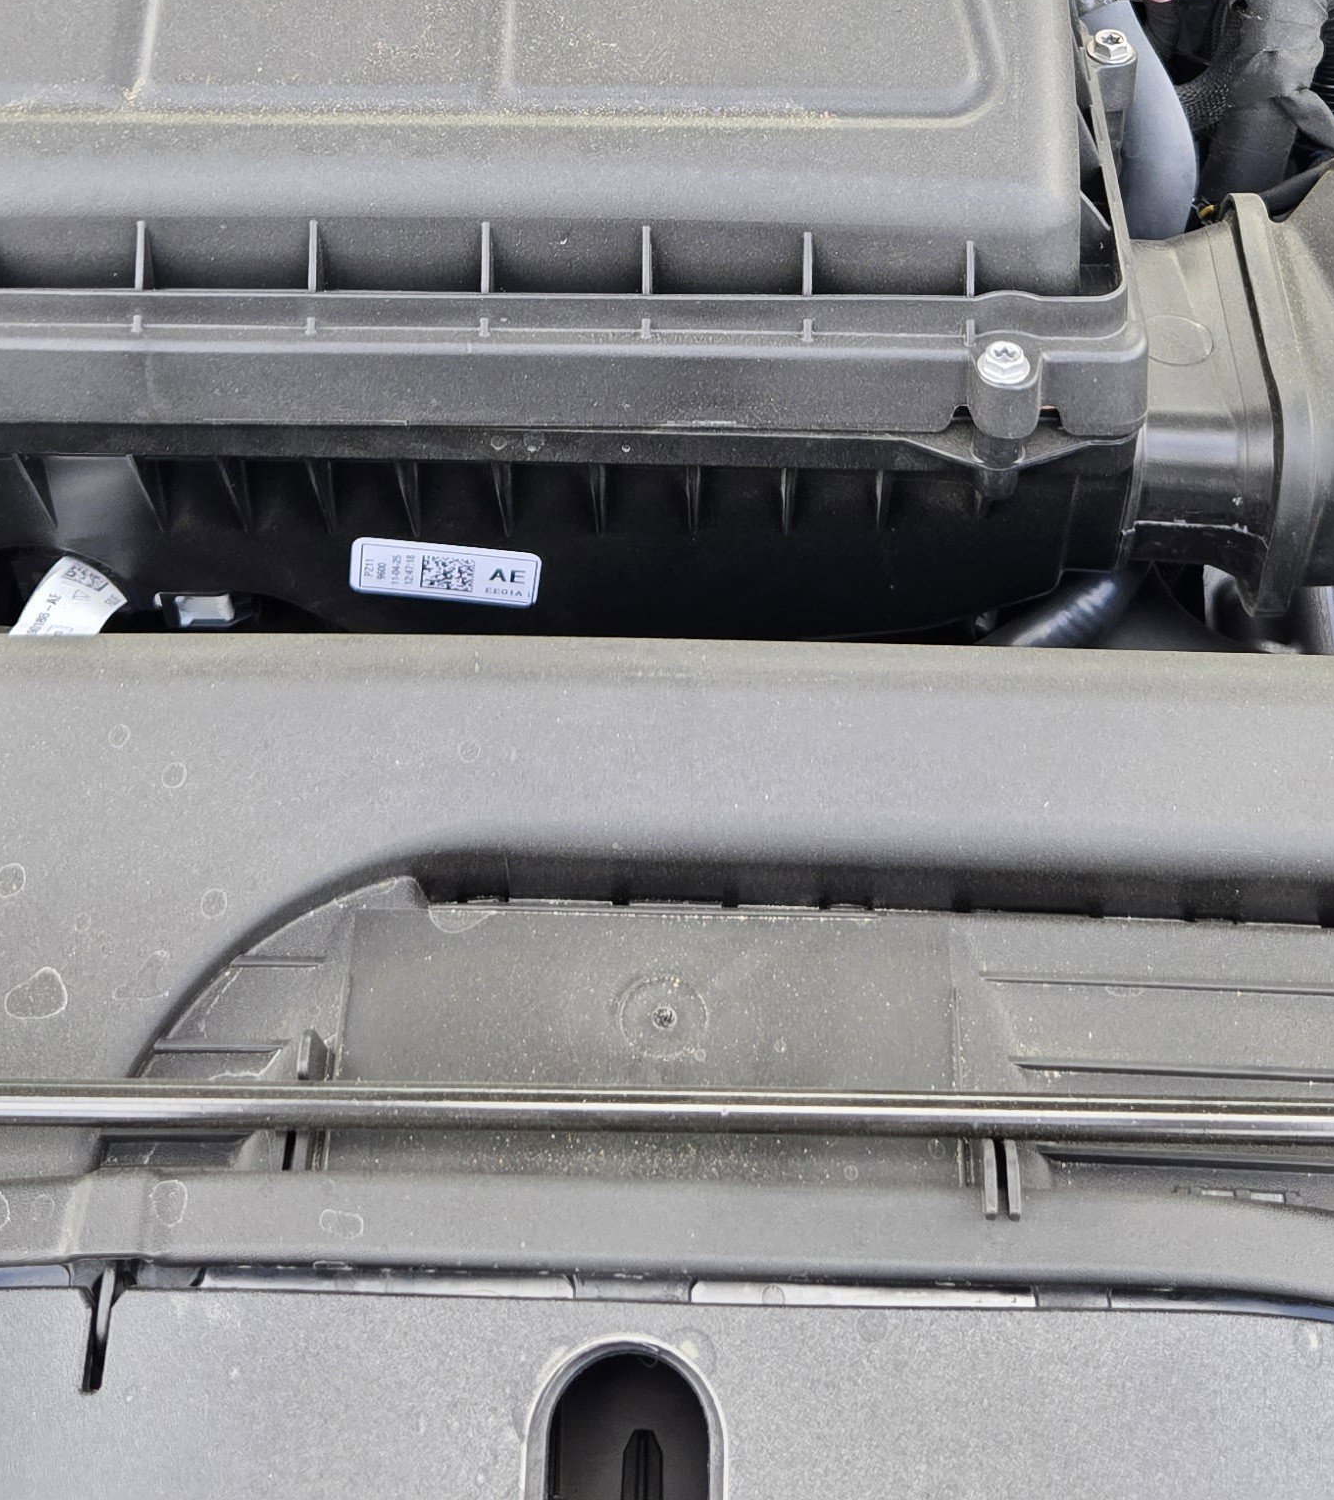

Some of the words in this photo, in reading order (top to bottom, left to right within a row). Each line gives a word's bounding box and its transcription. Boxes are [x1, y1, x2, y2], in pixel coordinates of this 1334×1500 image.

[363, 557, 374, 577] PZ11
[376, 562, 387, 579] 9600
[391, 554, 401, 584] 11-04-25
[403, 554, 415, 584] 12:47:18
[488, 567, 526, 584] AE
[484, 586, 523, 597] EE01A
